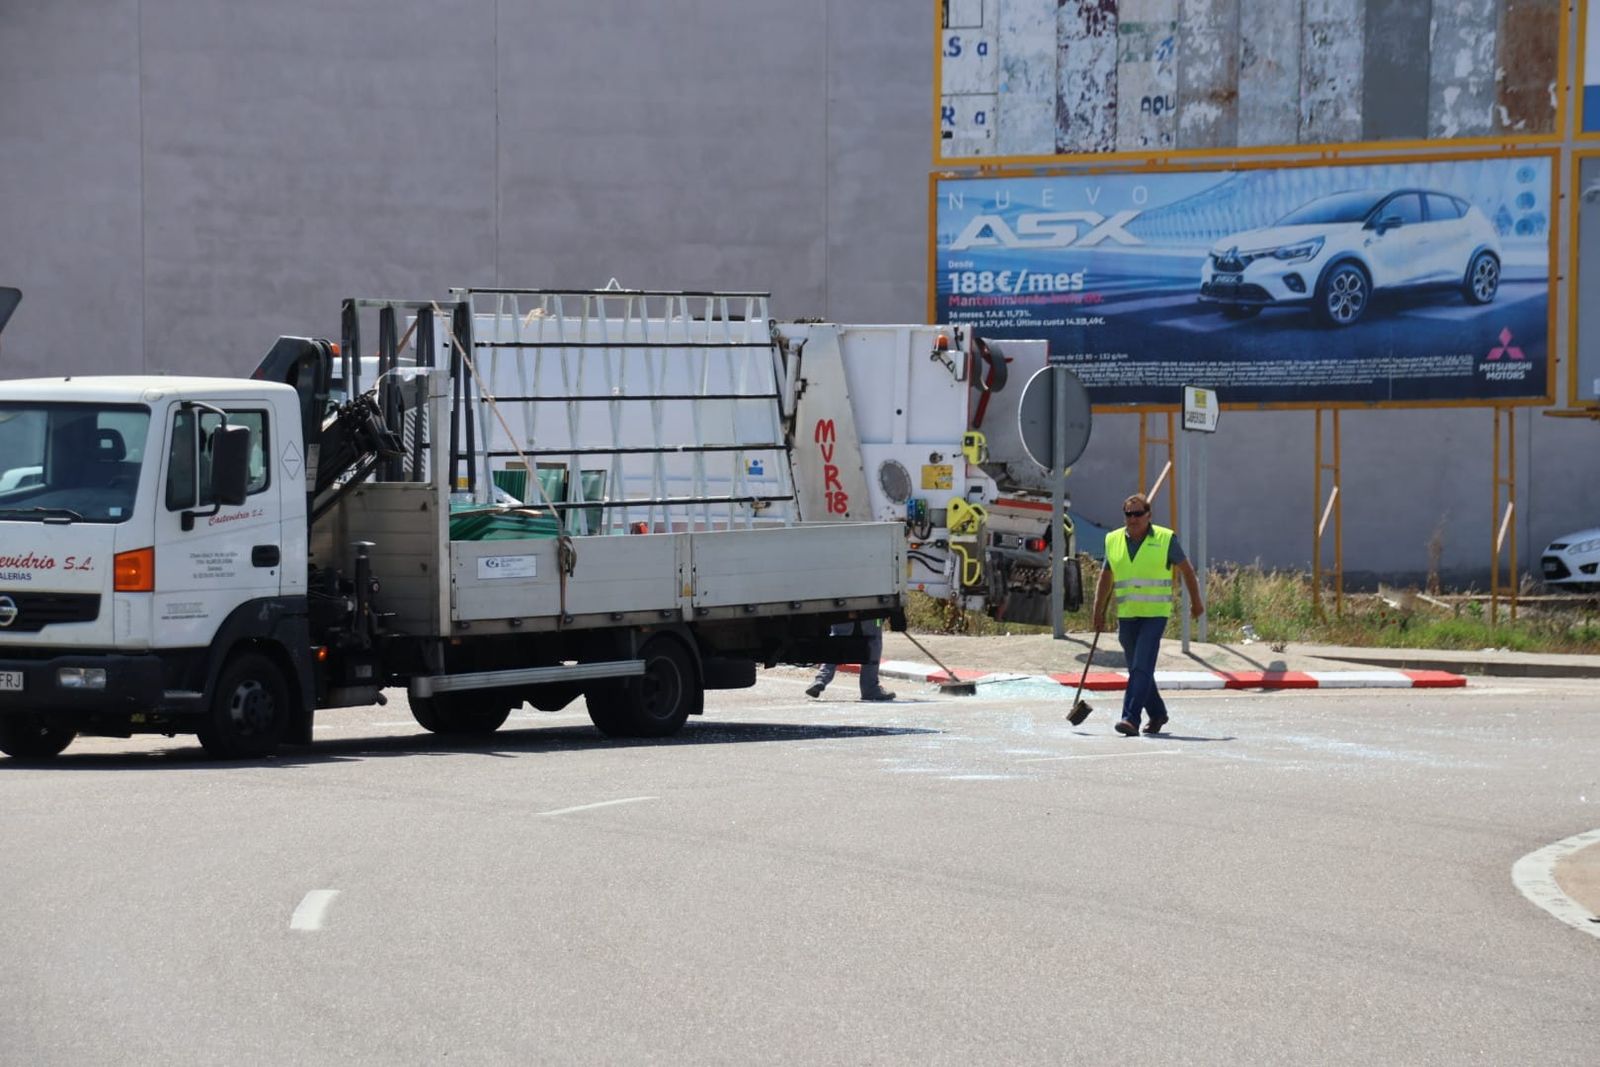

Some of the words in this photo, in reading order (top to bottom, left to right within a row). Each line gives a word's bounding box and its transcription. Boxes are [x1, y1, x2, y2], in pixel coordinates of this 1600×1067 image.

[944, 36, 962, 57] S
[949, 185, 1148, 210] NUEVO
[949, 209, 1146, 250] ASX
[948, 260, 974, 269] Desde
[1479, 361, 1532, 372] MITSUBISHI
[1486, 371, 1525, 380] MOTORS
[824, 491, 848, 514] 18
[63, 556, 95, 571] S.L.
